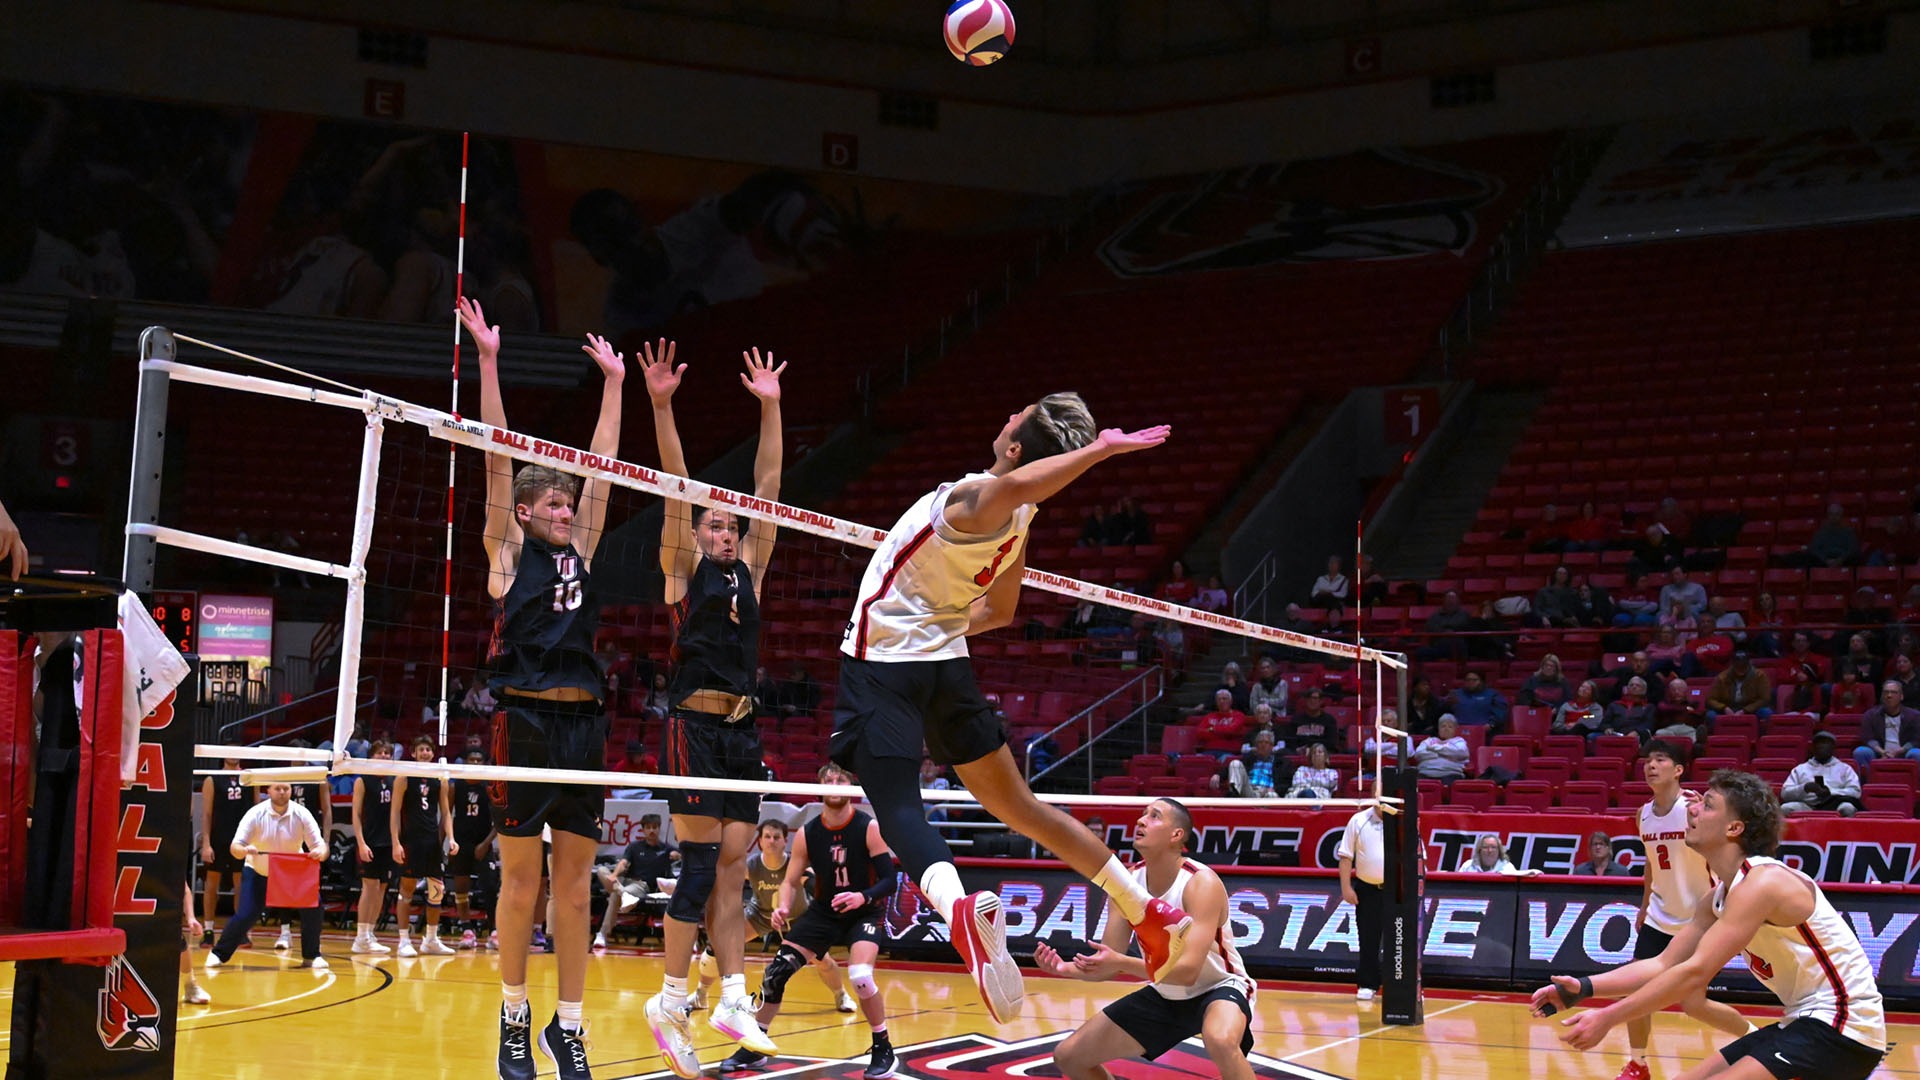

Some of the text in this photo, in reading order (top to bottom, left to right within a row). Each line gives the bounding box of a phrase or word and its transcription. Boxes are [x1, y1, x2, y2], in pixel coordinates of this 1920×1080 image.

[376, 91, 393, 115] E
[832, 144, 848, 165] D
[1403, 405, 1419, 437] 1
[54, 435, 78, 466] 3
[492, 428, 658, 486] BALL STATE VOLLEYBALL
[709, 487, 836, 530] BALL STATE VOLLEYBALL
[551, 551, 578, 581] TU
[1042, 573, 1081, 592] VOLLEYBALL
[553, 580, 582, 612] 10
[1105, 589, 1170, 613] BALL STATE VOLLEYBALL
[181, 608, 191, 621] 8
[218, 605, 270, 616] minnetrista
[228, 787, 241, 800] 22
[380, 790, 391, 803] 19
[421, 797, 429, 810] 5
[466, 804, 479, 816] 13
[830, 845, 847, 864] TU
[1656, 845, 1671, 870] 2
[834, 867, 850, 887] 11
[864, 923, 876, 935] TU
[1229, 886, 1489, 959] STAE
[1394, 917, 1403, 980] sports imports
